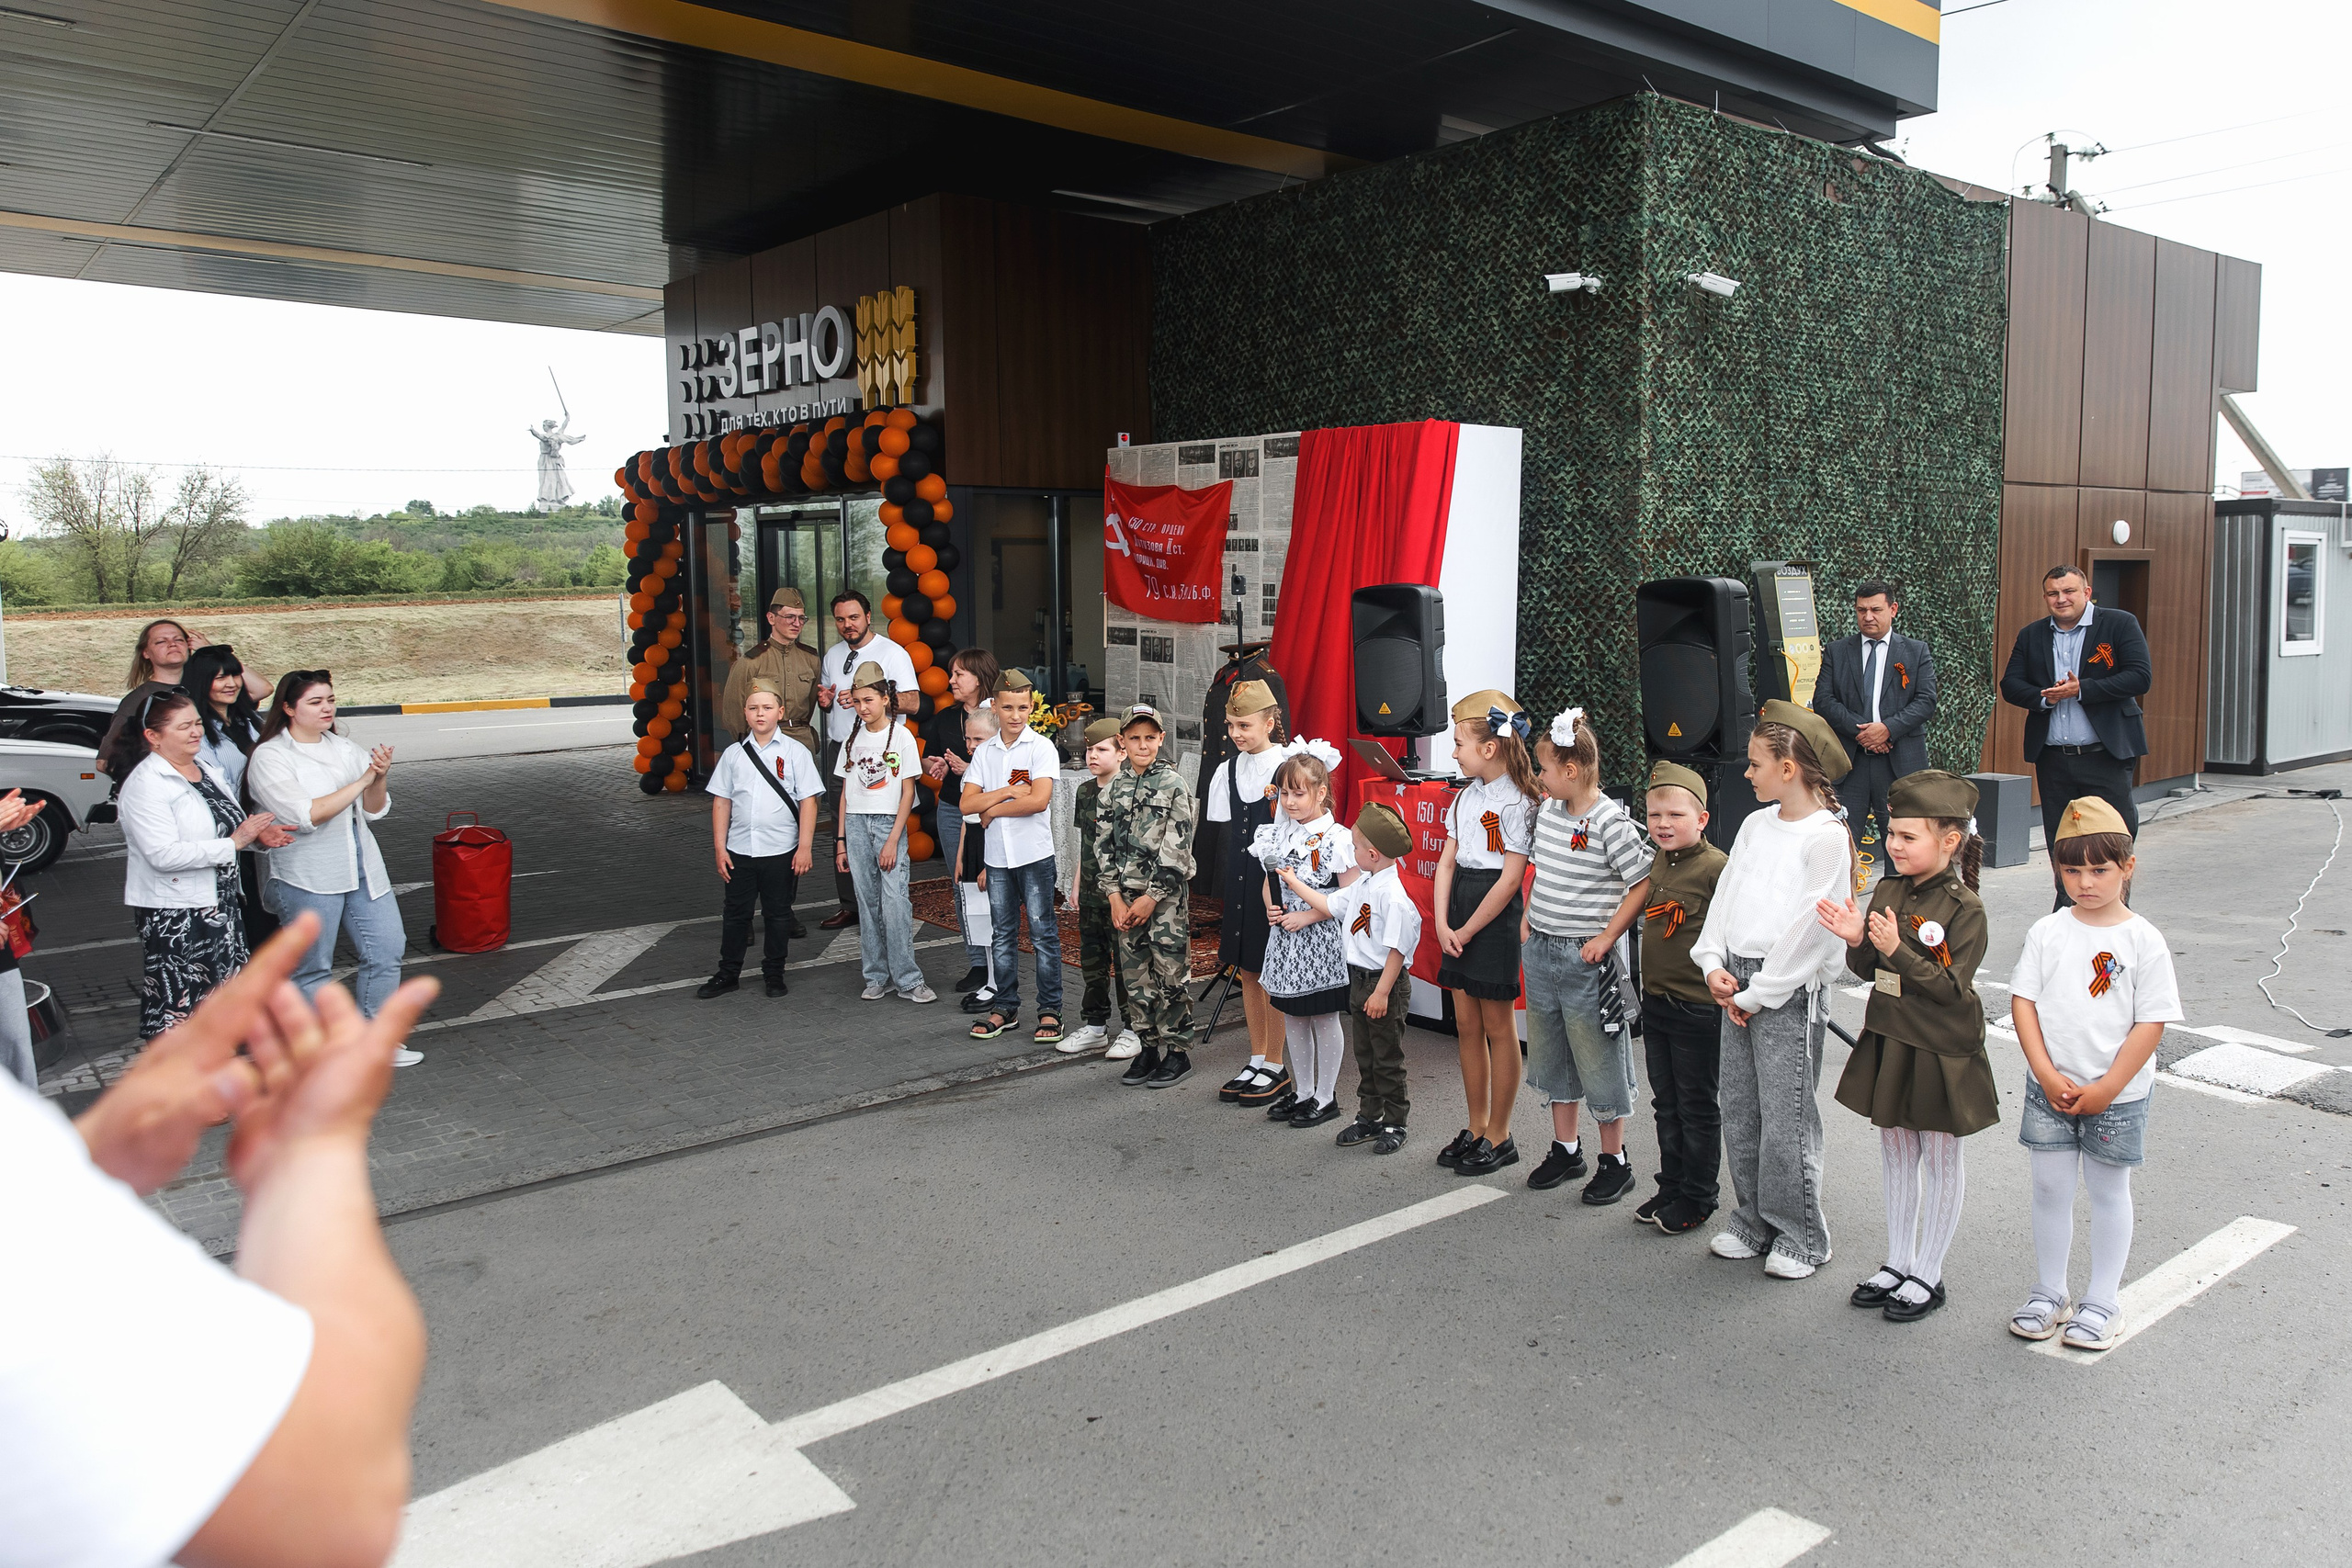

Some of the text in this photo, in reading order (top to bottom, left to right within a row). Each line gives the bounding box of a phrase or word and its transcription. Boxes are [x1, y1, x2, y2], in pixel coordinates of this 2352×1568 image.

[718, 305, 848, 398] ЗЕРНО
[721, 398, 846, 434] ДЛЯ ТЕХ, КТО В ПУТИ
[1145, 574, 1159, 600] 79
[1417, 801, 1434, 824] 150
[1417, 859, 1438, 879] ИДР
